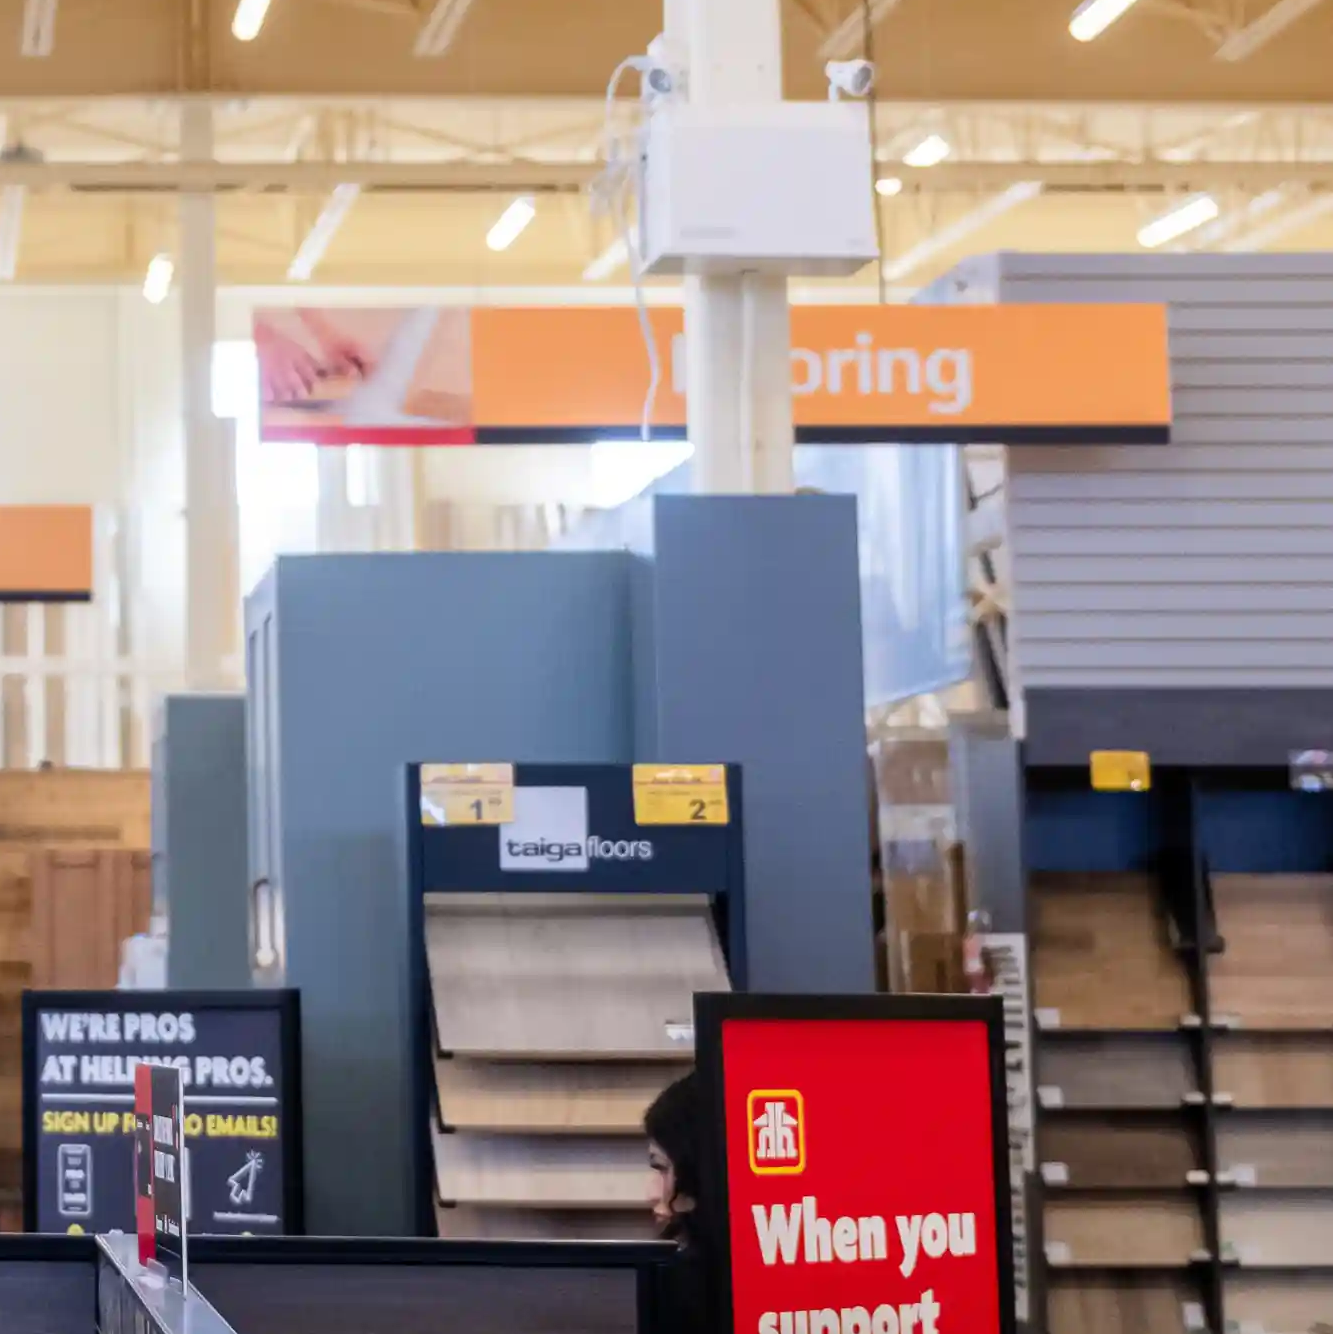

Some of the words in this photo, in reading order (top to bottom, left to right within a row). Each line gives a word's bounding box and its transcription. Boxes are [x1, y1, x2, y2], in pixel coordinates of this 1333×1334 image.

[671, 331, 974, 414] oring
[124, 1013, 196, 1043] PROS
[41, 1055, 77, 1083] AT
[196, 1056, 274, 1087] PROS.
[42, 1110, 90, 1133] SIGN
[93, 1112, 120, 1134] UP
[206, 1115, 279, 1137] EMAILS!
[751, 1196, 888, 1266] When
[895, 1212, 977, 1278] you
